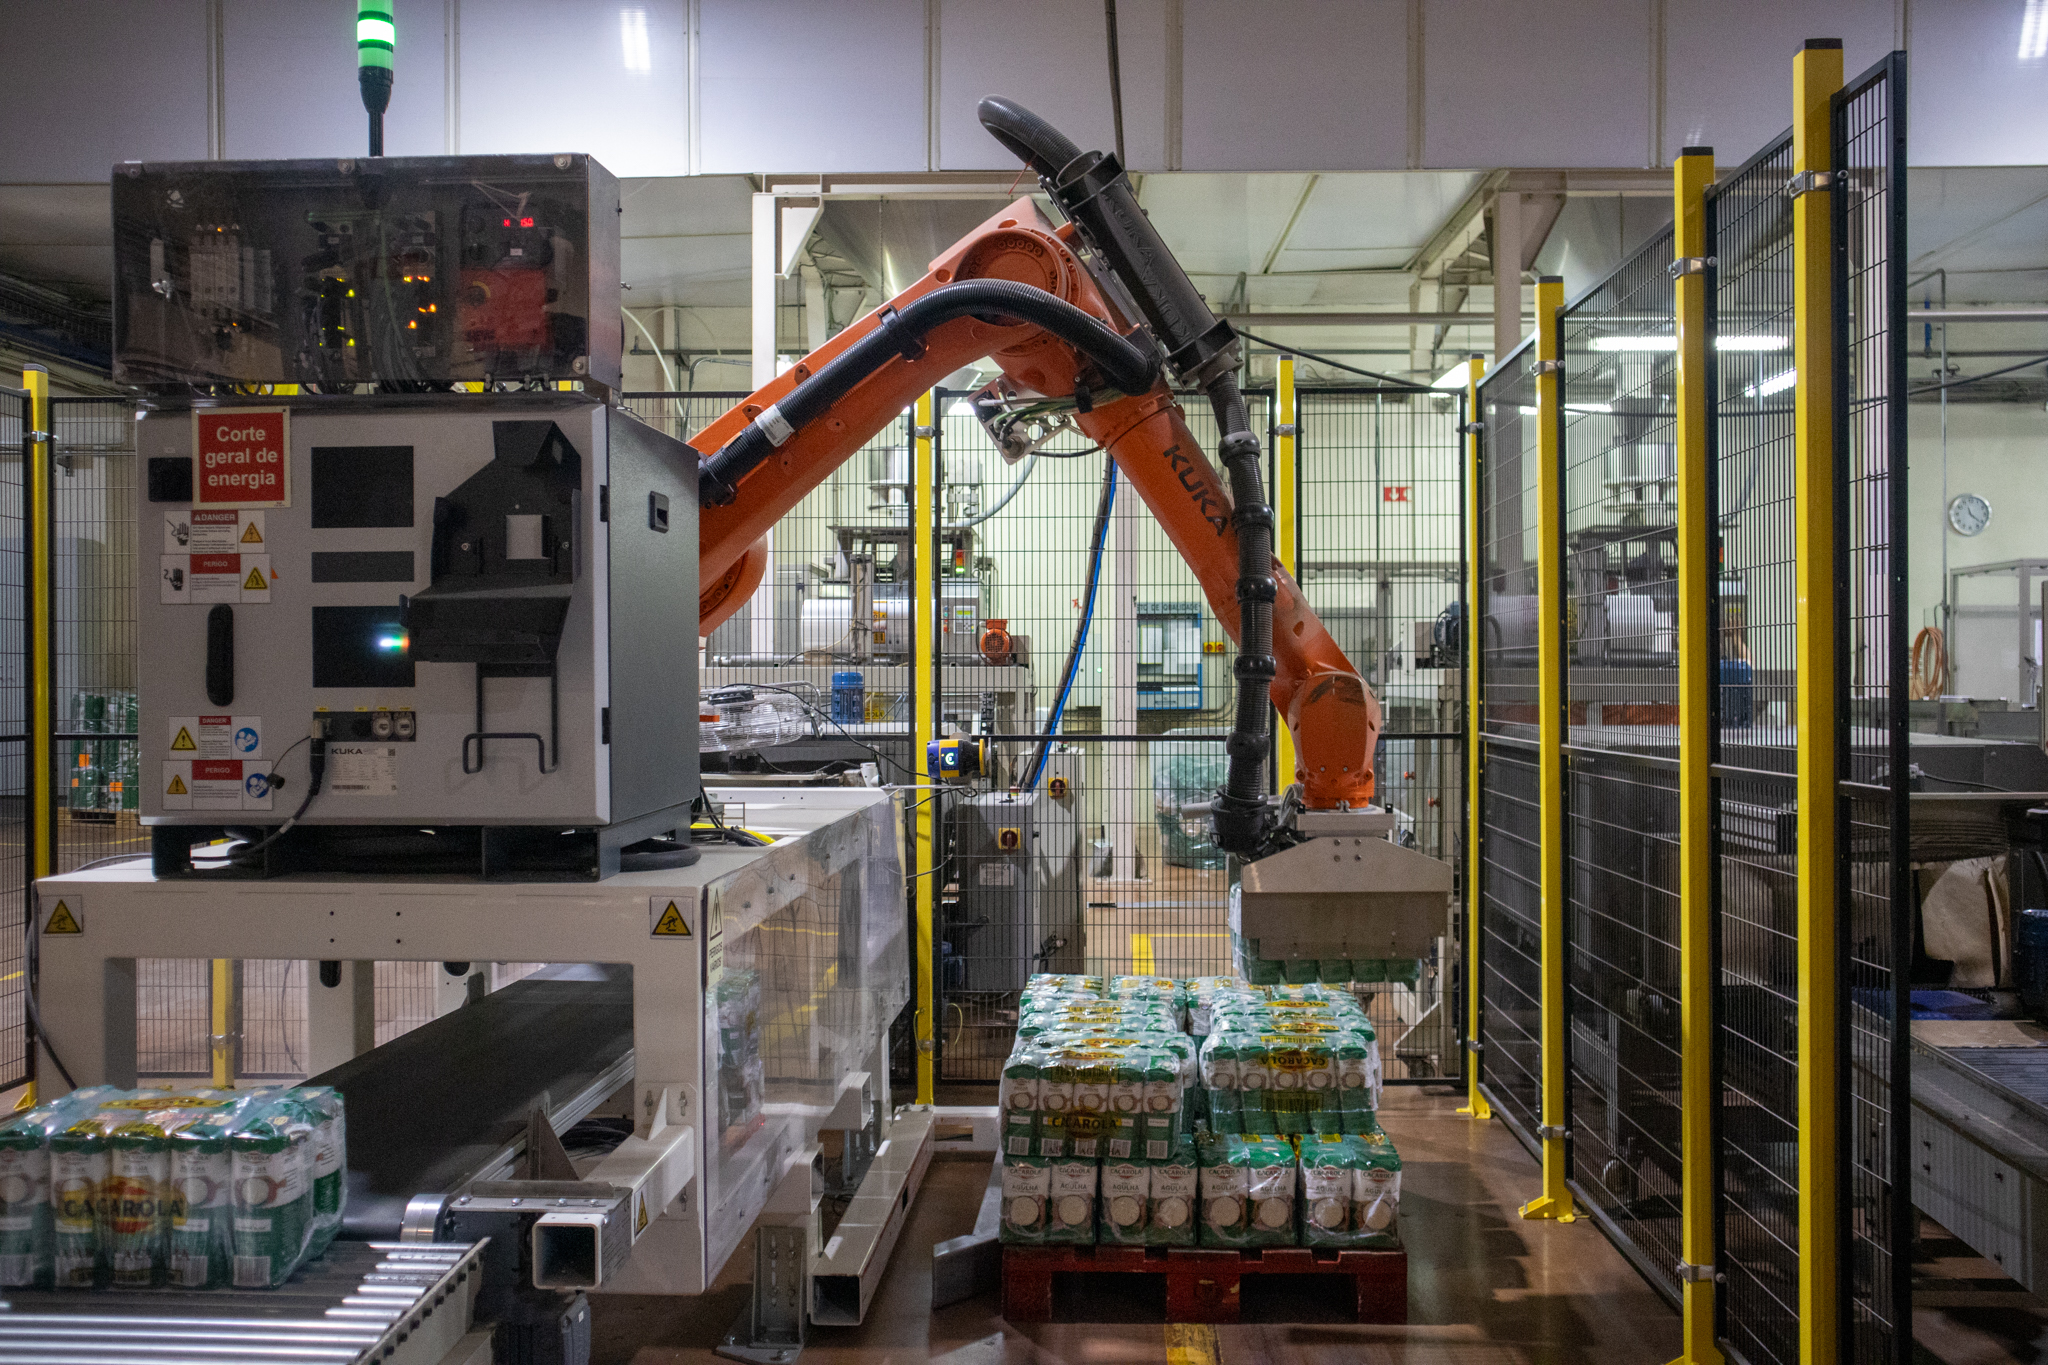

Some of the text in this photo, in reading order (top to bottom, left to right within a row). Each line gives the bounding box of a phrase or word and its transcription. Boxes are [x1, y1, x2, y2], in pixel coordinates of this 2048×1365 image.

[216, 425, 266, 442] Corte
[205, 448, 278, 468] geral de
[207, 469, 276, 489] energia
[1162, 444, 1229, 538] KUKA
[201, 513, 236, 521] DANGER
